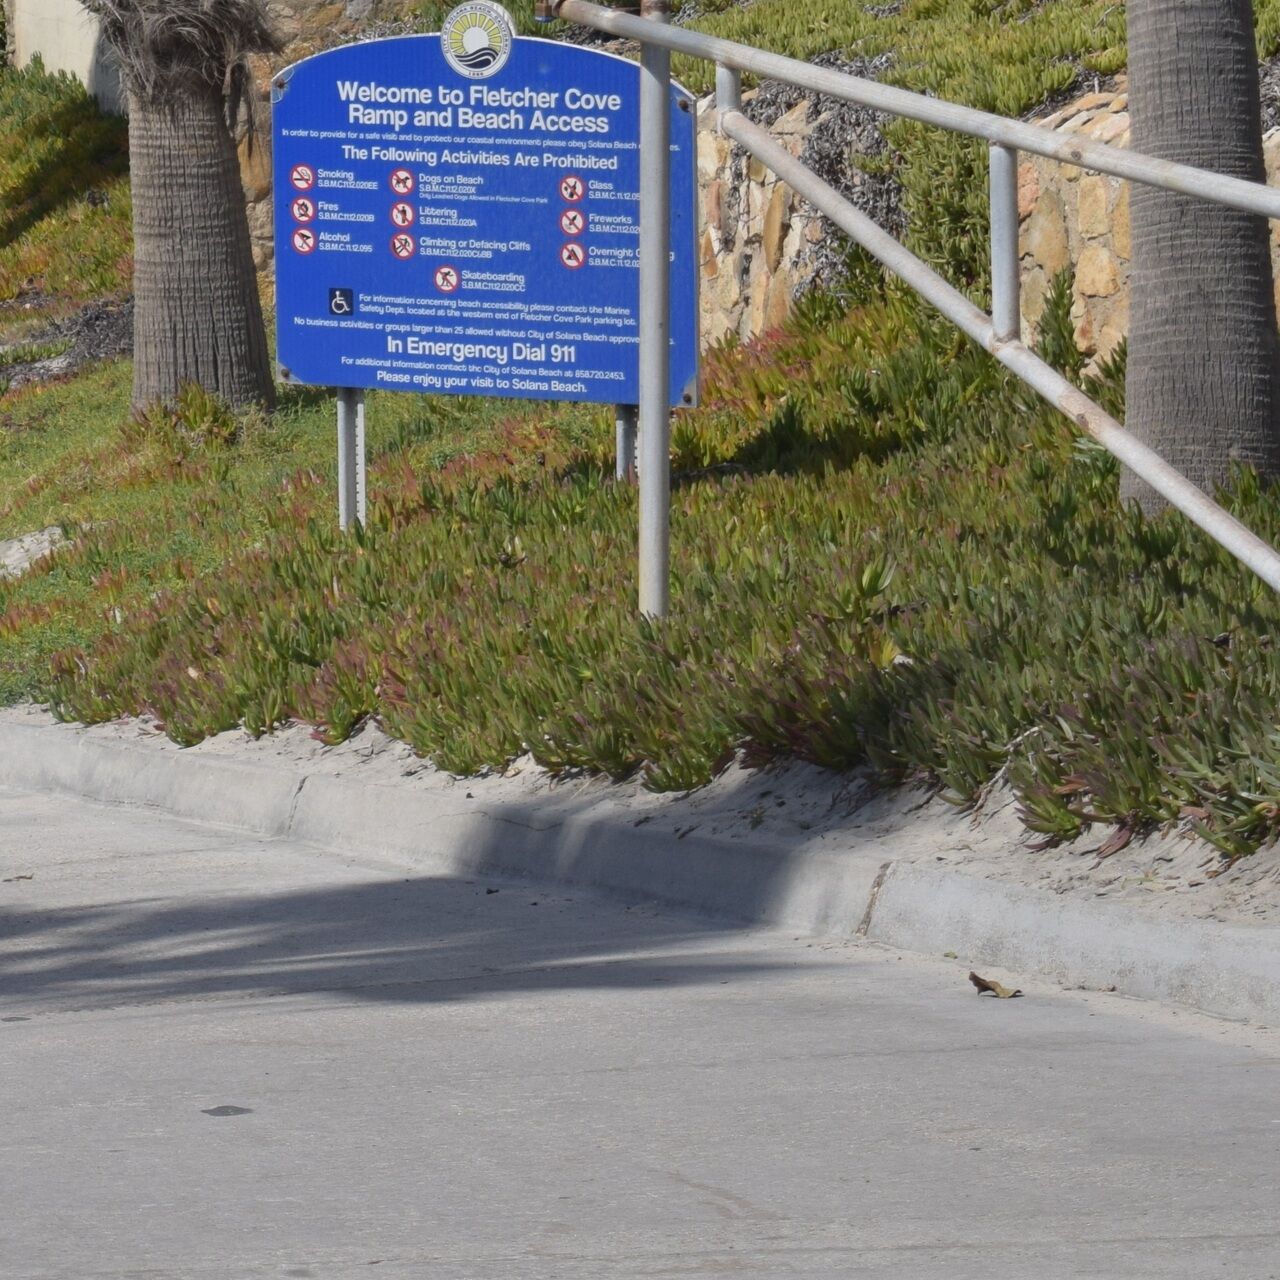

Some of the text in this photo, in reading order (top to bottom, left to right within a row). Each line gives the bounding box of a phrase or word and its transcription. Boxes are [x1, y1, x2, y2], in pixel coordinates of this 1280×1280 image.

[337, 81, 621, 111] Welcome to Fletcher Cove
[349, 104, 608, 132] Ramp and Beach Access
[290, 129, 308, 137] order
[320, 131, 346, 139] provide
[348, 131, 358, 139] for
[382, 133, 397, 141] visit
[424, 135, 452, 143] protect
[467, 136, 494, 144] coastal
[495, 137, 541, 146] environment
[543, 139, 566, 148] please
[568, 140, 586, 149] obey
[588, 140, 612, 149] Solana
[614, 141, 637, 149] Beach
[342, 145, 617, 169] The Following Activities Are Prohibited
[318, 169, 354, 180] Smoking
[419, 174, 441, 184] Dogs
[457, 175, 483, 184] Beach
[589, 180, 613, 190] Glass
[318, 202, 338, 211] Fires
[419, 207, 457, 218] Littering
[589, 214, 632, 223] Fireworks
[319, 232, 350, 241] Alcohol
[420, 237, 456, 248] Climbing
[469, 240, 506, 251] Defacing
[509, 241, 530, 250] Cliffs
[589, 247, 633, 258] Overnight
[462, 271, 524, 284] Skateboarding
[359, 294, 630, 315] For information concerning beach accessibility please contact the Marine
[359, 304, 384, 314] Safety
[385, 305, 405, 315] Dept.
[407, 306, 435, 315] located
[447, 308, 460, 317] the
[462, 310, 493, 319] western
[520, 313, 551, 321] Fletcher
[575, 315, 592, 323] Park
[593, 316, 622, 327] parking
[623, 317, 637, 325] lot.
[294, 317, 304, 325] No
[306, 318, 338, 327] business
[340, 320, 374, 329] activities
[385, 324, 410, 332] groups
[412, 324, 433, 334] larger
[435, 326, 452, 334] than
[465, 327, 493, 336] allowed
[495, 329, 526, 338] without
[528, 331, 544, 340] City
[546, 331, 554, 339] of
[555, 332, 581, 340] Solana
[583, 333, 607, 341] Beach
[387, 336, 575, 363] In Emergency Dial 911
[341, 357, 354, 365] For
[355, 357, 390, 367] additional
[392, 360, 435, 369] information
[436, 363, 467, 371] contact
[483, 365, 499, 375] City
[501, 366, 510, 374] of
[511, 367, 537, 375] Solana
[539, 368, 562, 376] Beach
[377, 371, 587, 392] Please enjoy your visit to Solana Beach.
